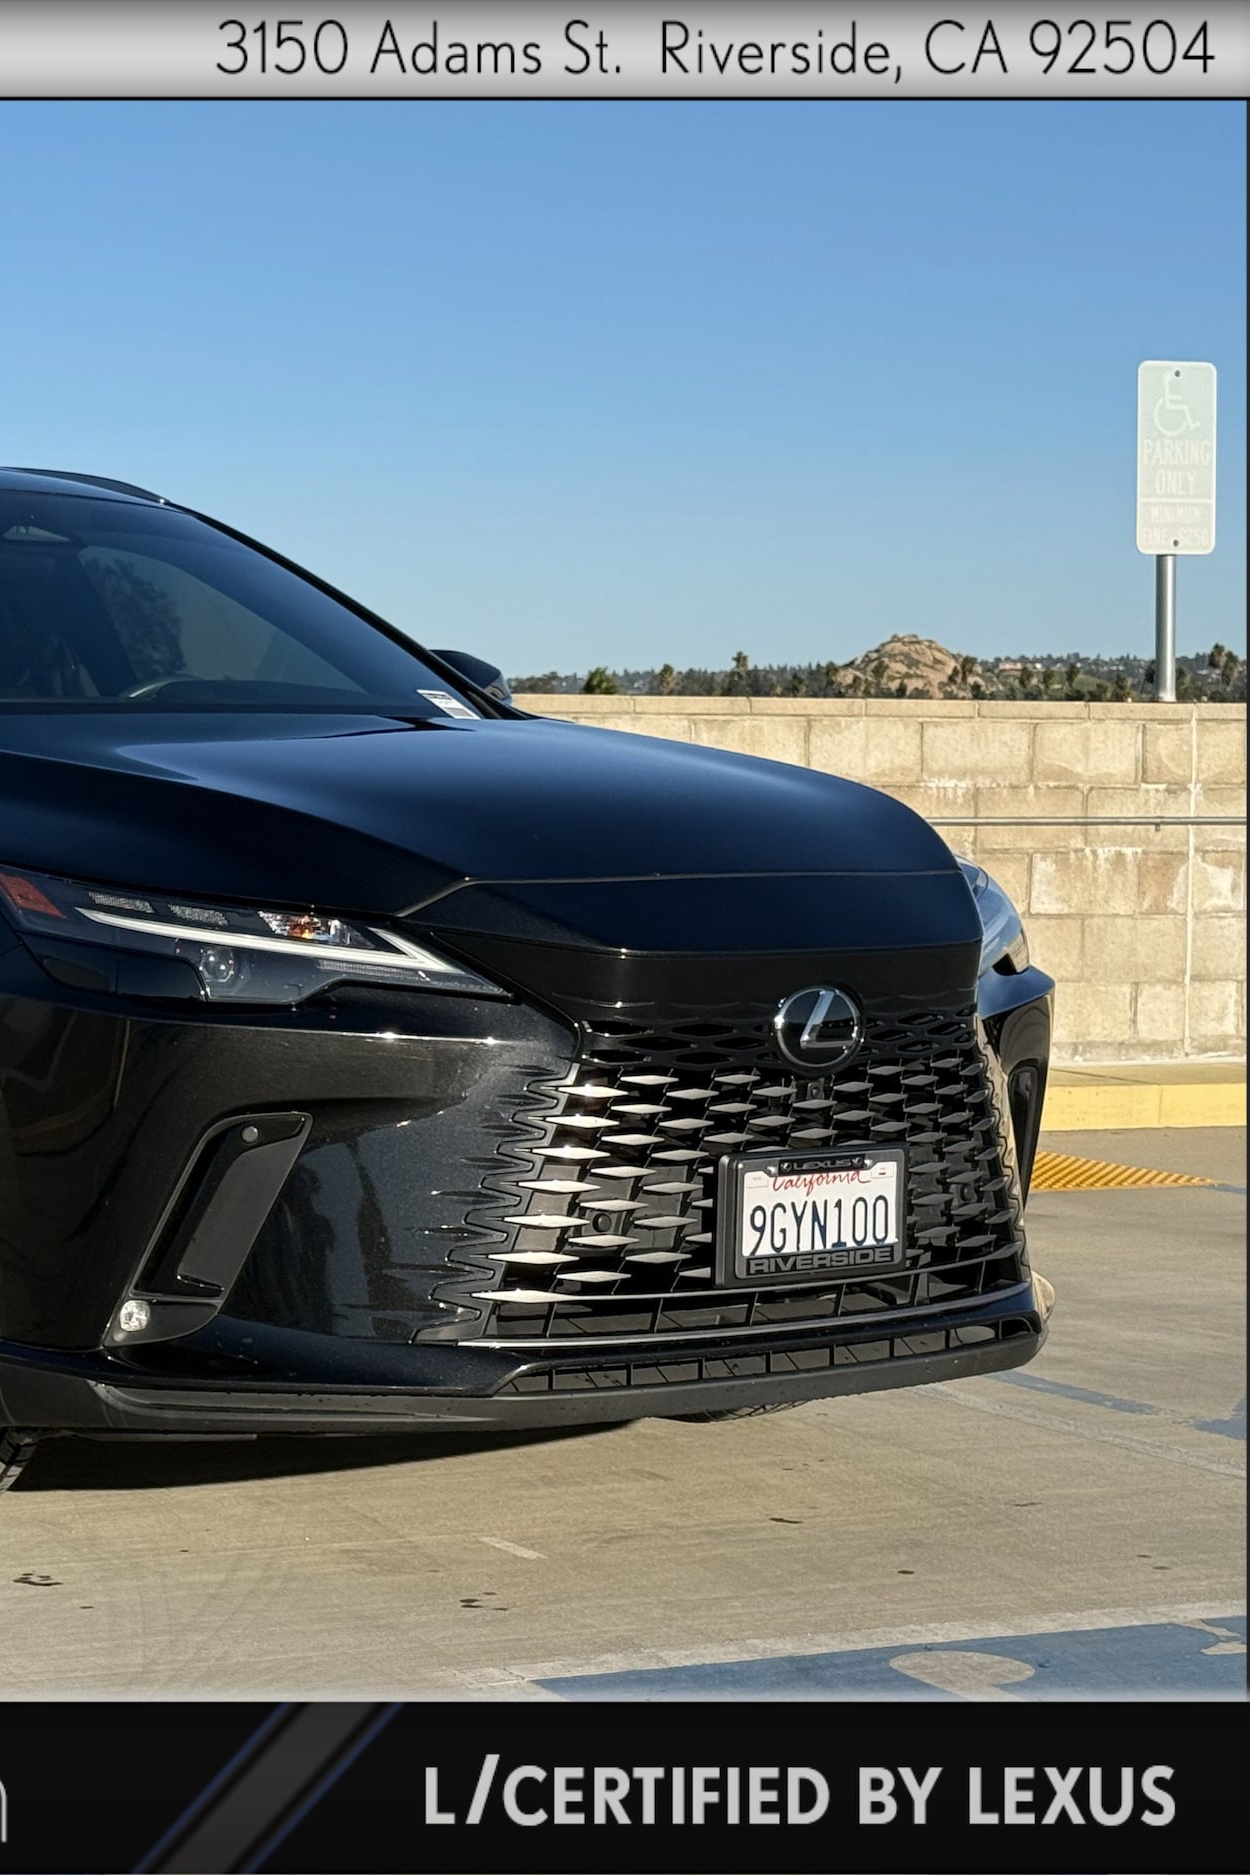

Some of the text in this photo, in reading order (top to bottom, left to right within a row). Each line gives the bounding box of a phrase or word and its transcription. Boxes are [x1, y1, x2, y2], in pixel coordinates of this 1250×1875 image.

[1142, 439, 1211, 466] PARKING
[1155, 469, 1197, 497] ONLY
[793, 1160, 852, 1171] LEXUS
[749, 1194, 889, 1257] 9GYN100
[749, 1249, 892, 1275] RIVERSIDE
